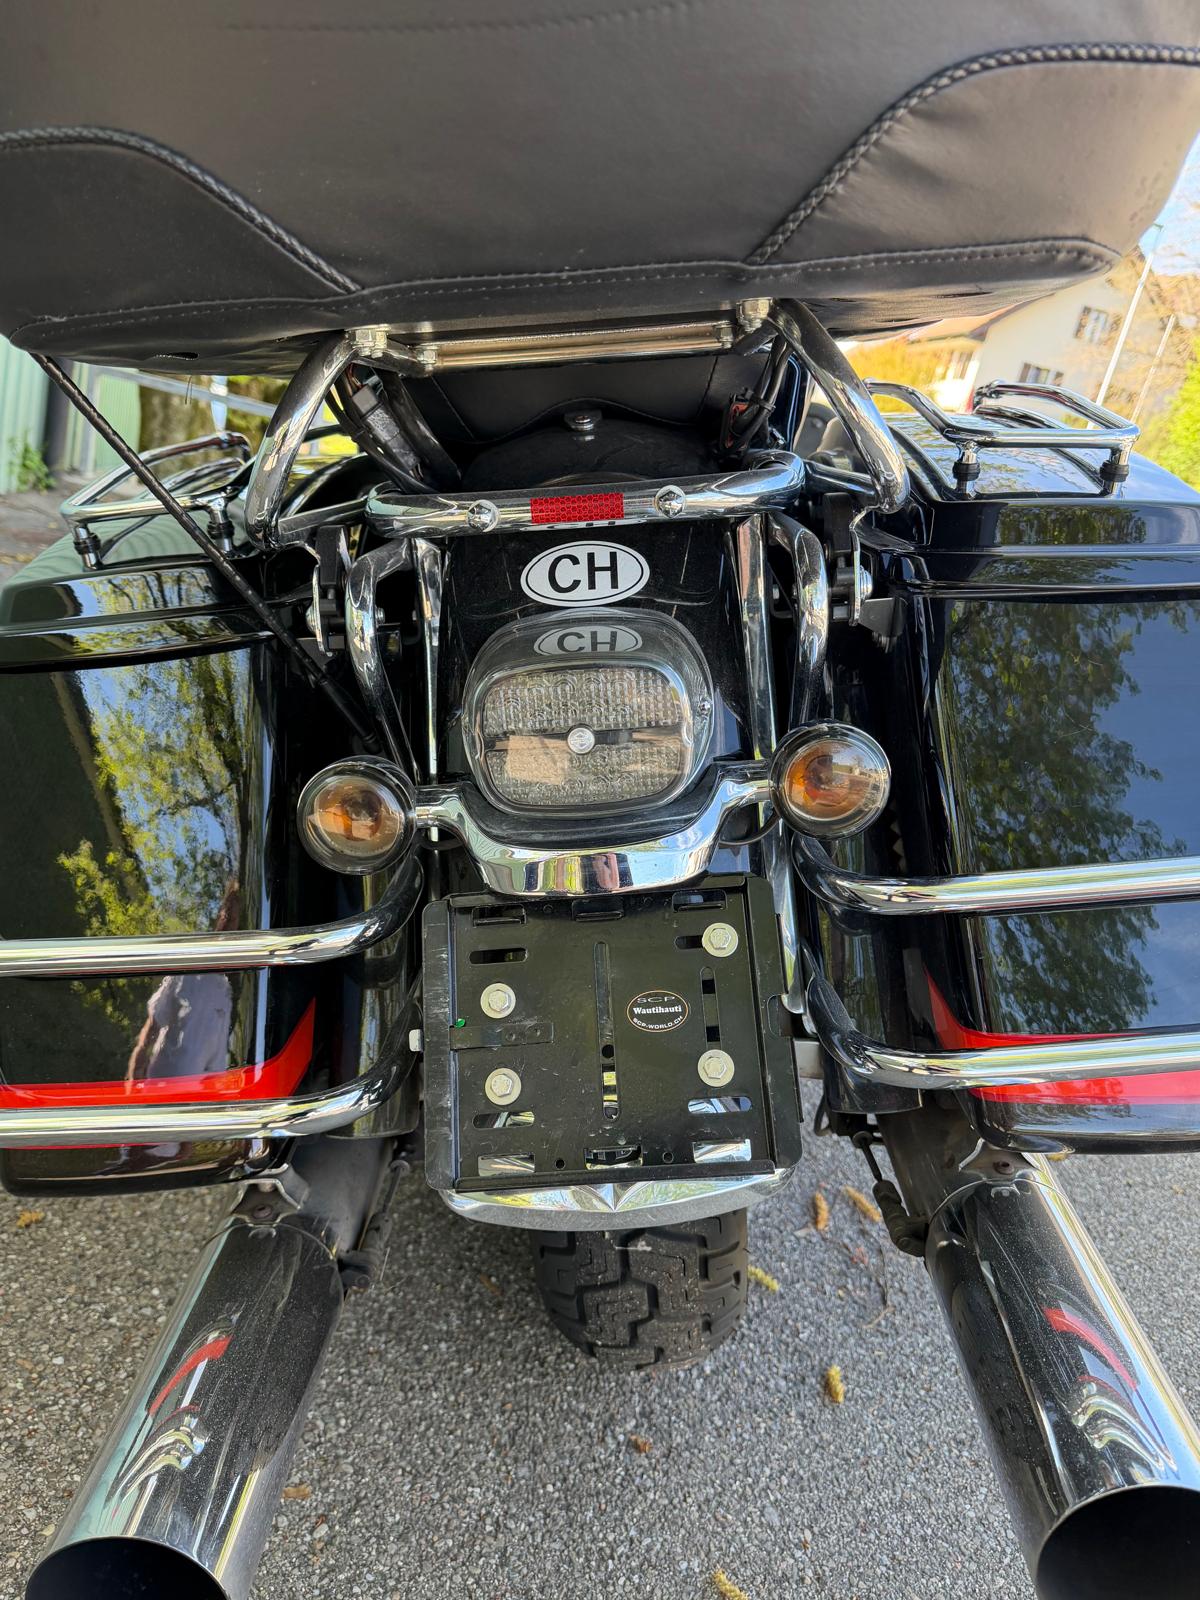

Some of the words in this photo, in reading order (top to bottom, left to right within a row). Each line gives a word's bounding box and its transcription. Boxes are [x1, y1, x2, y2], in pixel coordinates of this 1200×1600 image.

[548, 551, 619, 594] CH
[637, 996, 675, 1004] SCP
[633, 1005, 682, 1015] Wautihauti
